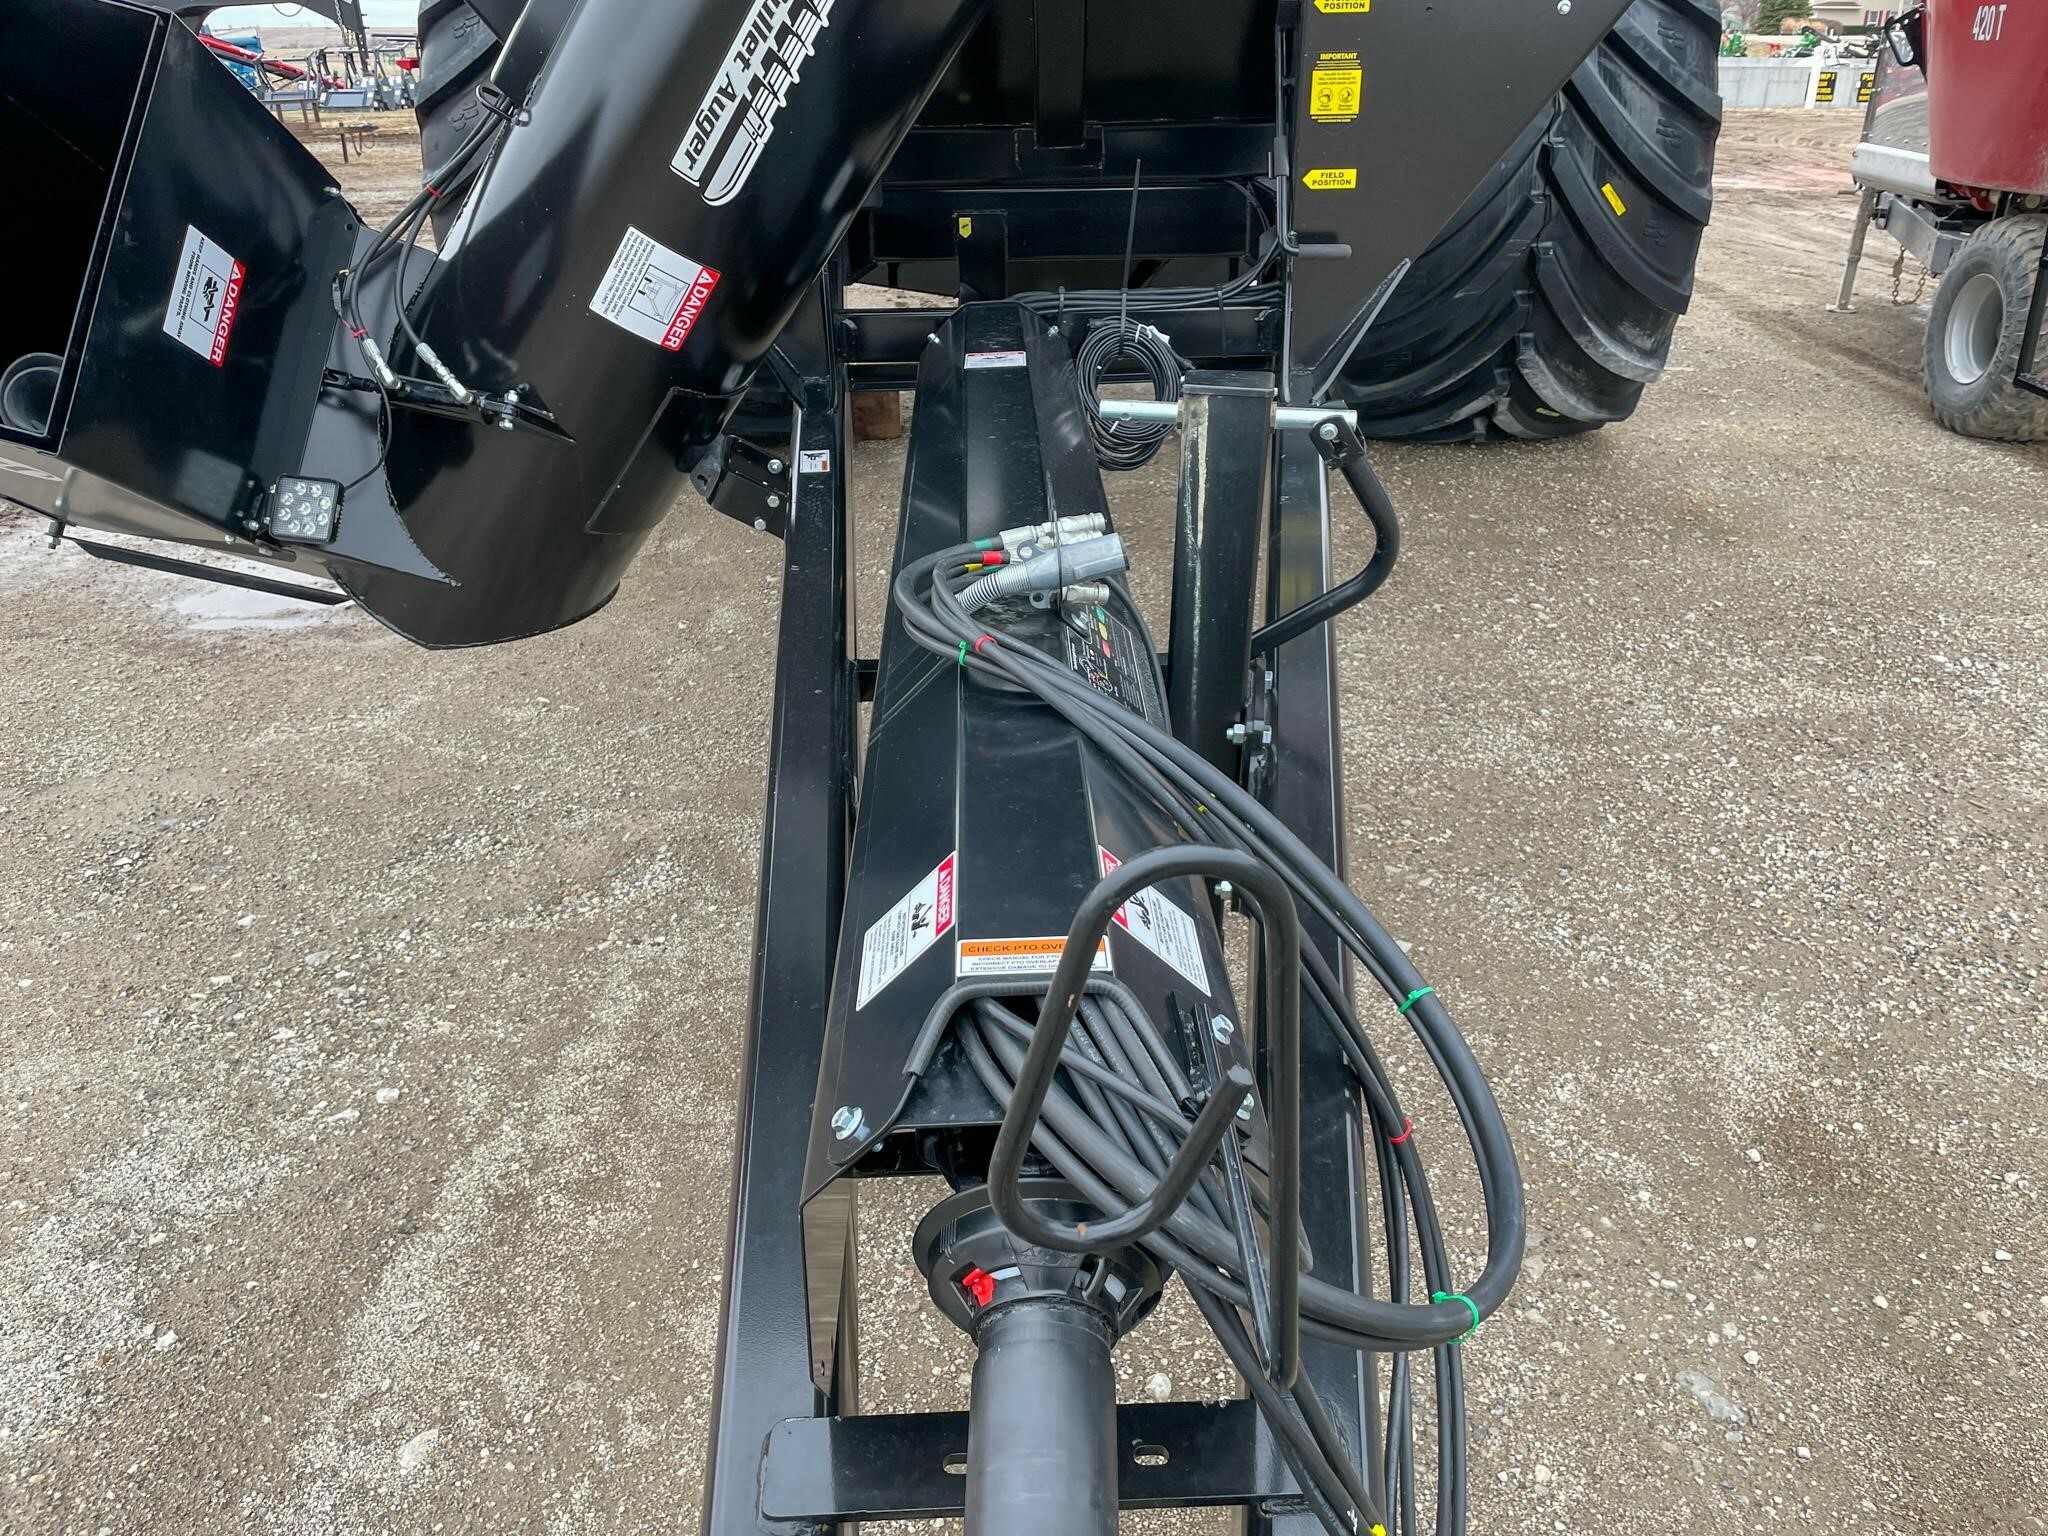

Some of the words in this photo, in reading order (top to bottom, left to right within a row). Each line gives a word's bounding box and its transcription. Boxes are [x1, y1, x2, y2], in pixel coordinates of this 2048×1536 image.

[733, 0, 789, 72] ullet
[1972, 5, 1996, 41] 420
[1996, 4, 2007, 40] T
[684, 71, 737, 171] Auger
[187, 250, 195, 270] FROM
[197, 236, 205, 253] KEEP
[192, 253, 201, 276] HANDS
[181, 269, 191, 295] MOVING
[180, 289, 192, 320] CLOTHING
[211, 281, 238, 362] DANGER
[664, 283, 708, 349] DANGER
[176, 320, 184, 338] AWAY
[938, 876, 951, 929] DANGER
